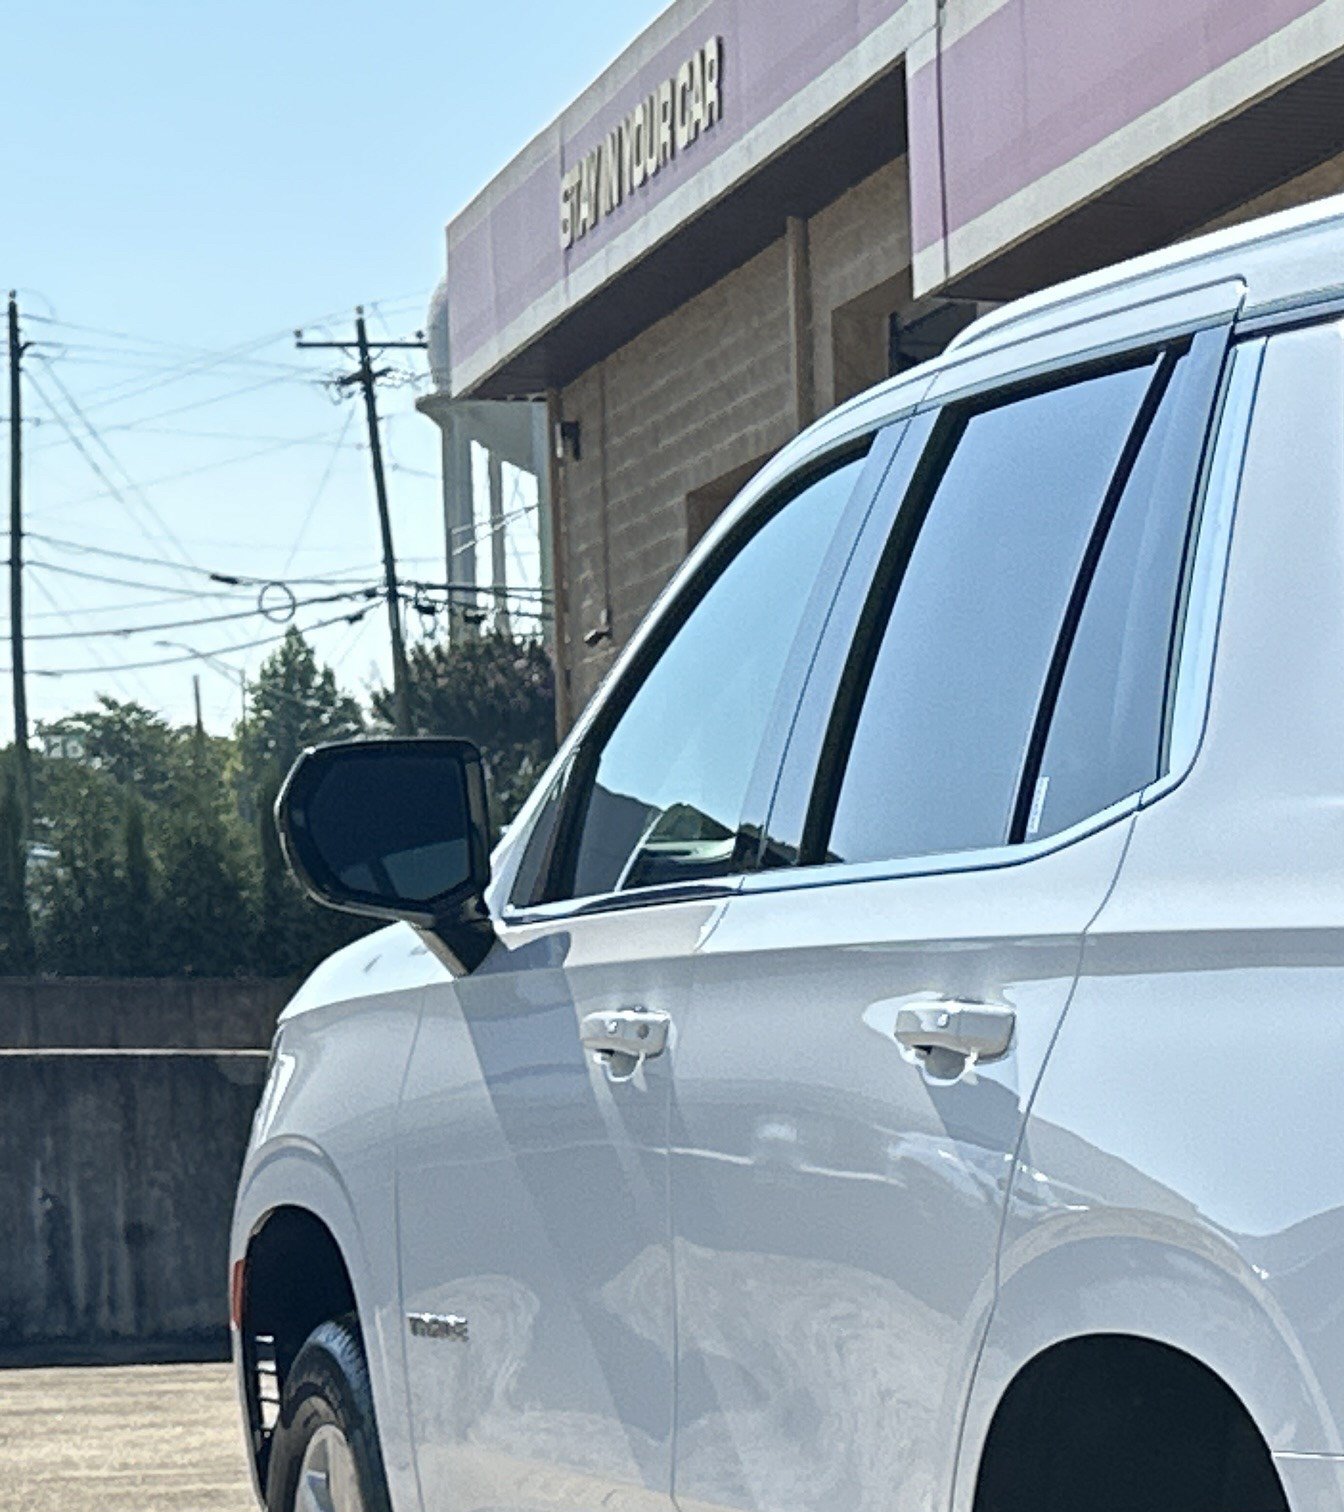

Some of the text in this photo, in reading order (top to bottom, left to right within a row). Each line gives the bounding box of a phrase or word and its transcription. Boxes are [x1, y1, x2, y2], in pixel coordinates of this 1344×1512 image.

[560, 34, 724, 250] STAY IN YOUR CAR
